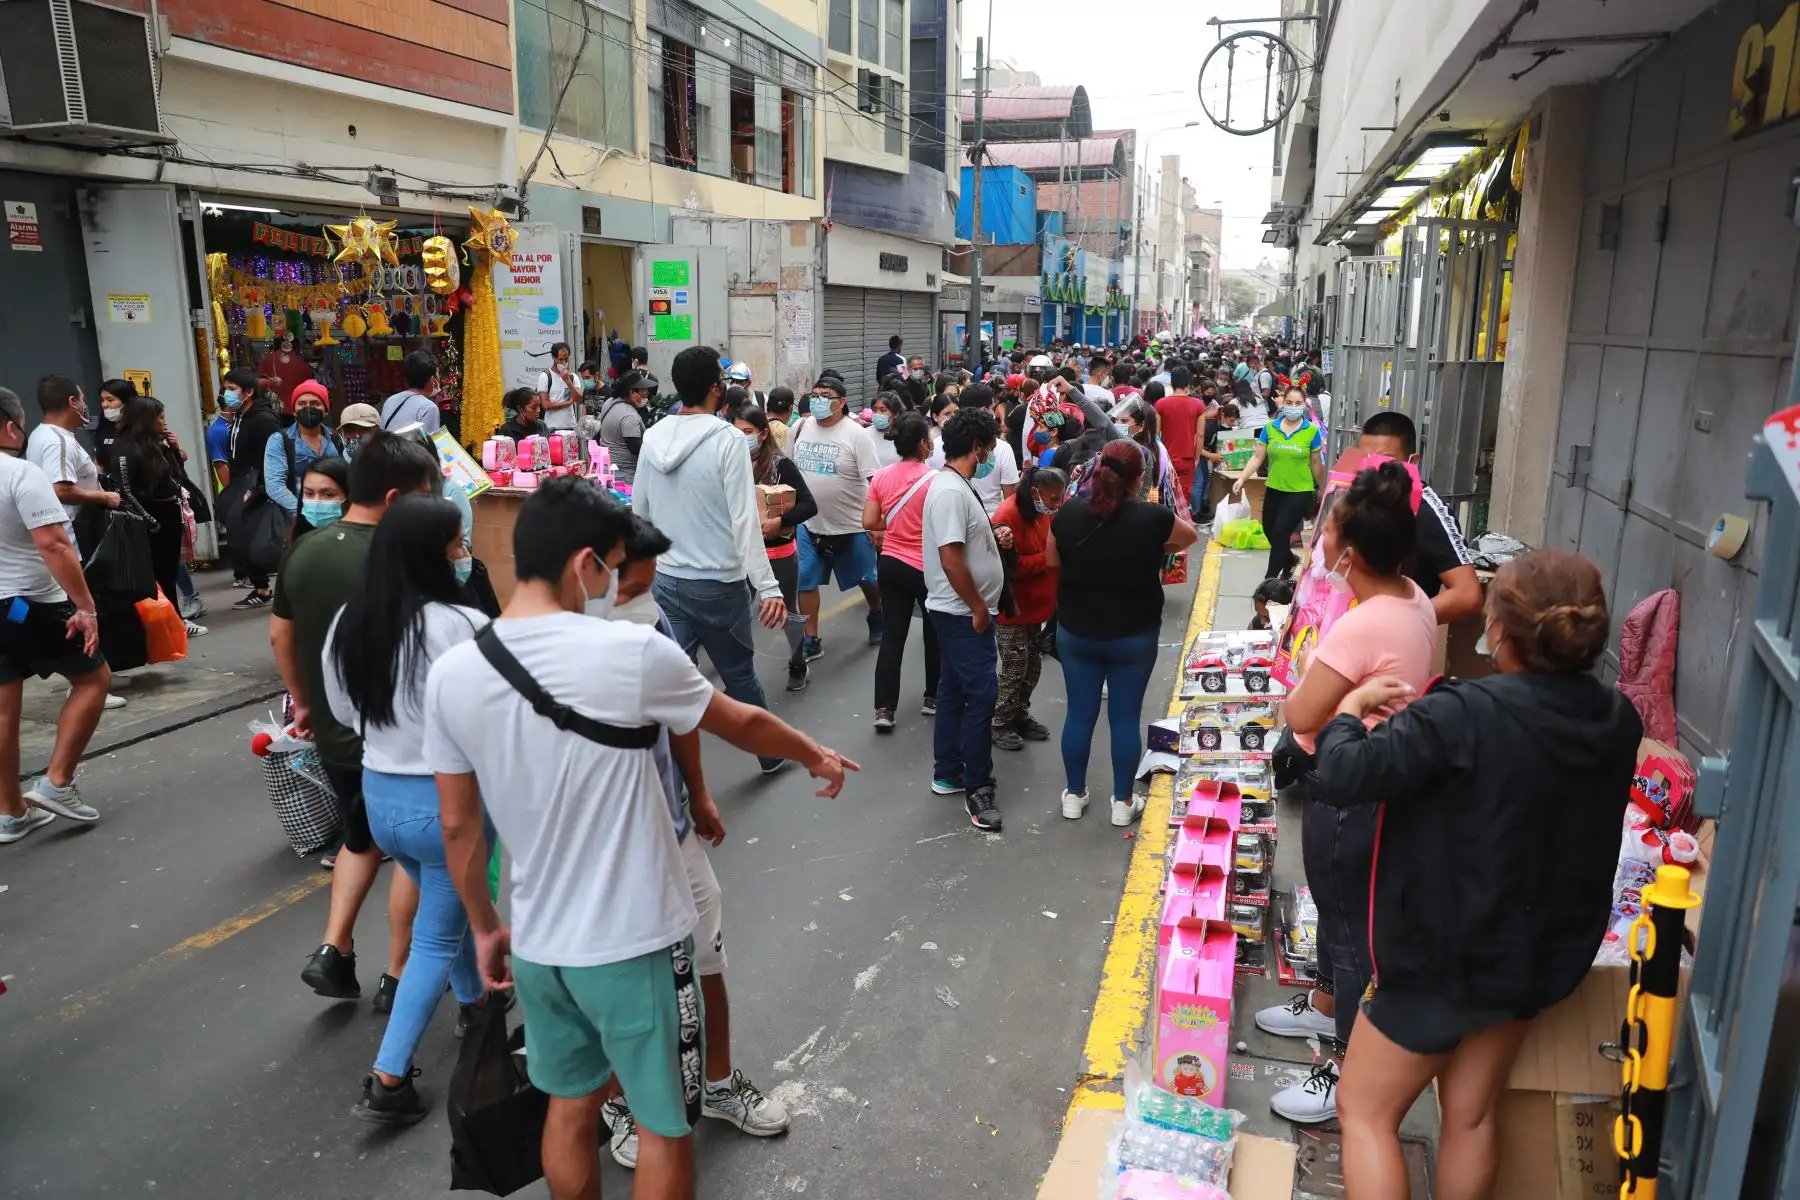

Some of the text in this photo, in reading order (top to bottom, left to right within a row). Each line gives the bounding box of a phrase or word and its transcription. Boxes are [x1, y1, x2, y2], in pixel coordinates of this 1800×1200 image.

[10, 222, 38, 231] Alarma
[256, 227, 325, 254] FELIZ
[525, 254, 535, 262] AL
[536, 254, 553, 263] POR
[538, 264, 544, 273] Y
[513, 275, 541, 284] MENOR
[822, 460, 835, 473] 73
